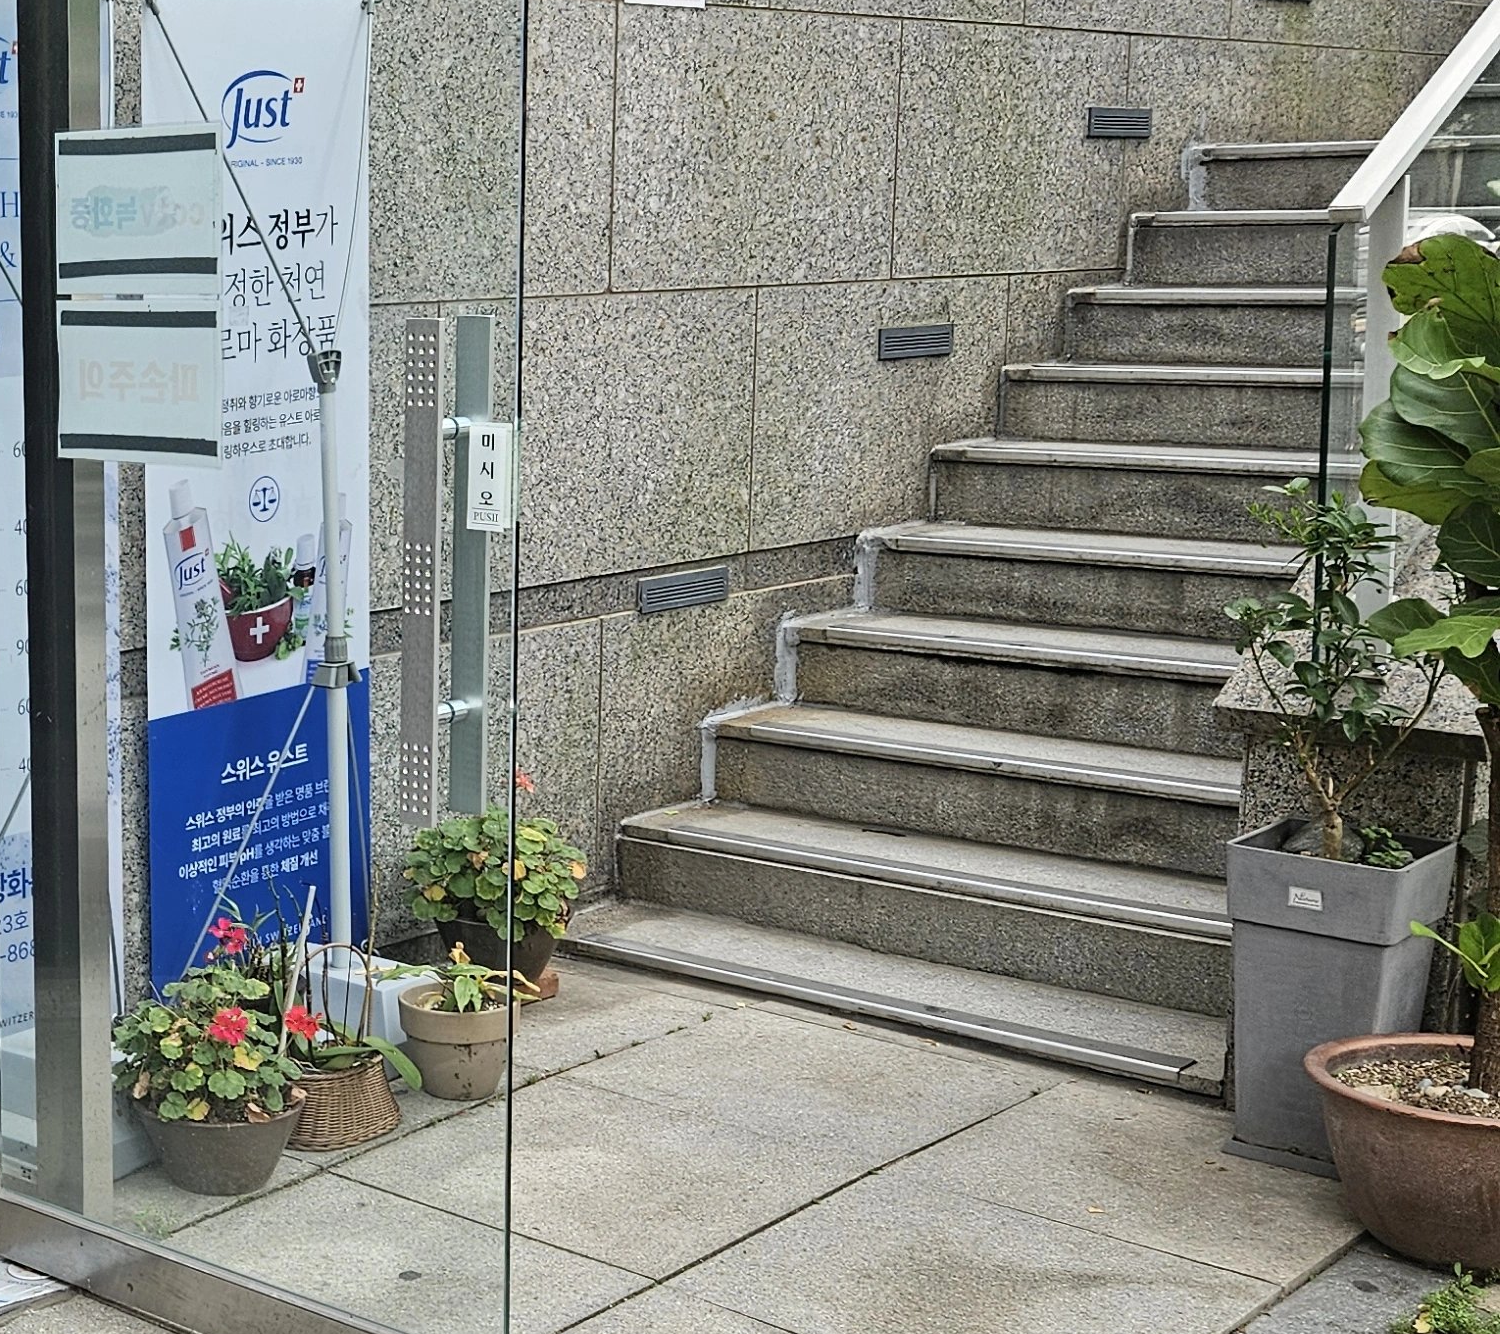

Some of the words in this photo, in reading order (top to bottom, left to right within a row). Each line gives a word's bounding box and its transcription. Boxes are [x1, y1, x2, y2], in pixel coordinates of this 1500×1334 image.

[225, 87, 293, 149] Just
[230, 157, 259, 168] RIGINAL
[265, 156, 286, 167] SINCE
[287, 156, 303, 166] 1930
[221, 212, 262, 255] 위스
[267, 204, 339, 251] 정부가
[0, 240, 18, 268] &
[224, 264, 275, 307] 정한
[279, 259, 326, 304] 천연
[221, 321, 263, 364] 로마
[267, 314, 336, 359] 화장품
[248, 391, 282, 410] 향기로운
[283, 386, 320, 404] 아로마향
[222, 420, 242, 437] 음을
[278, 411, 304, 428] 유스트
[304, 408, 321, 423] 아로
[223, 439, 267, 460] 링하우스로
[478, 433, 495, 506] 미시오
[178, 556, 207, 591] Just
[220, 754, 265, 785] 스위스
[185, 810, 216, 831] 스위스
[216, 800, 245, 823] 정부의
[275, 789, 295, 807] 받은
[191, 831, 221, 853] 최고의
[281, 805, 318, 828] 방법으로
[178, 855, 218, 880] 이상적인
[264, 833, 301, 856] 생각하는
[299, 849, 319, 867] 개선
